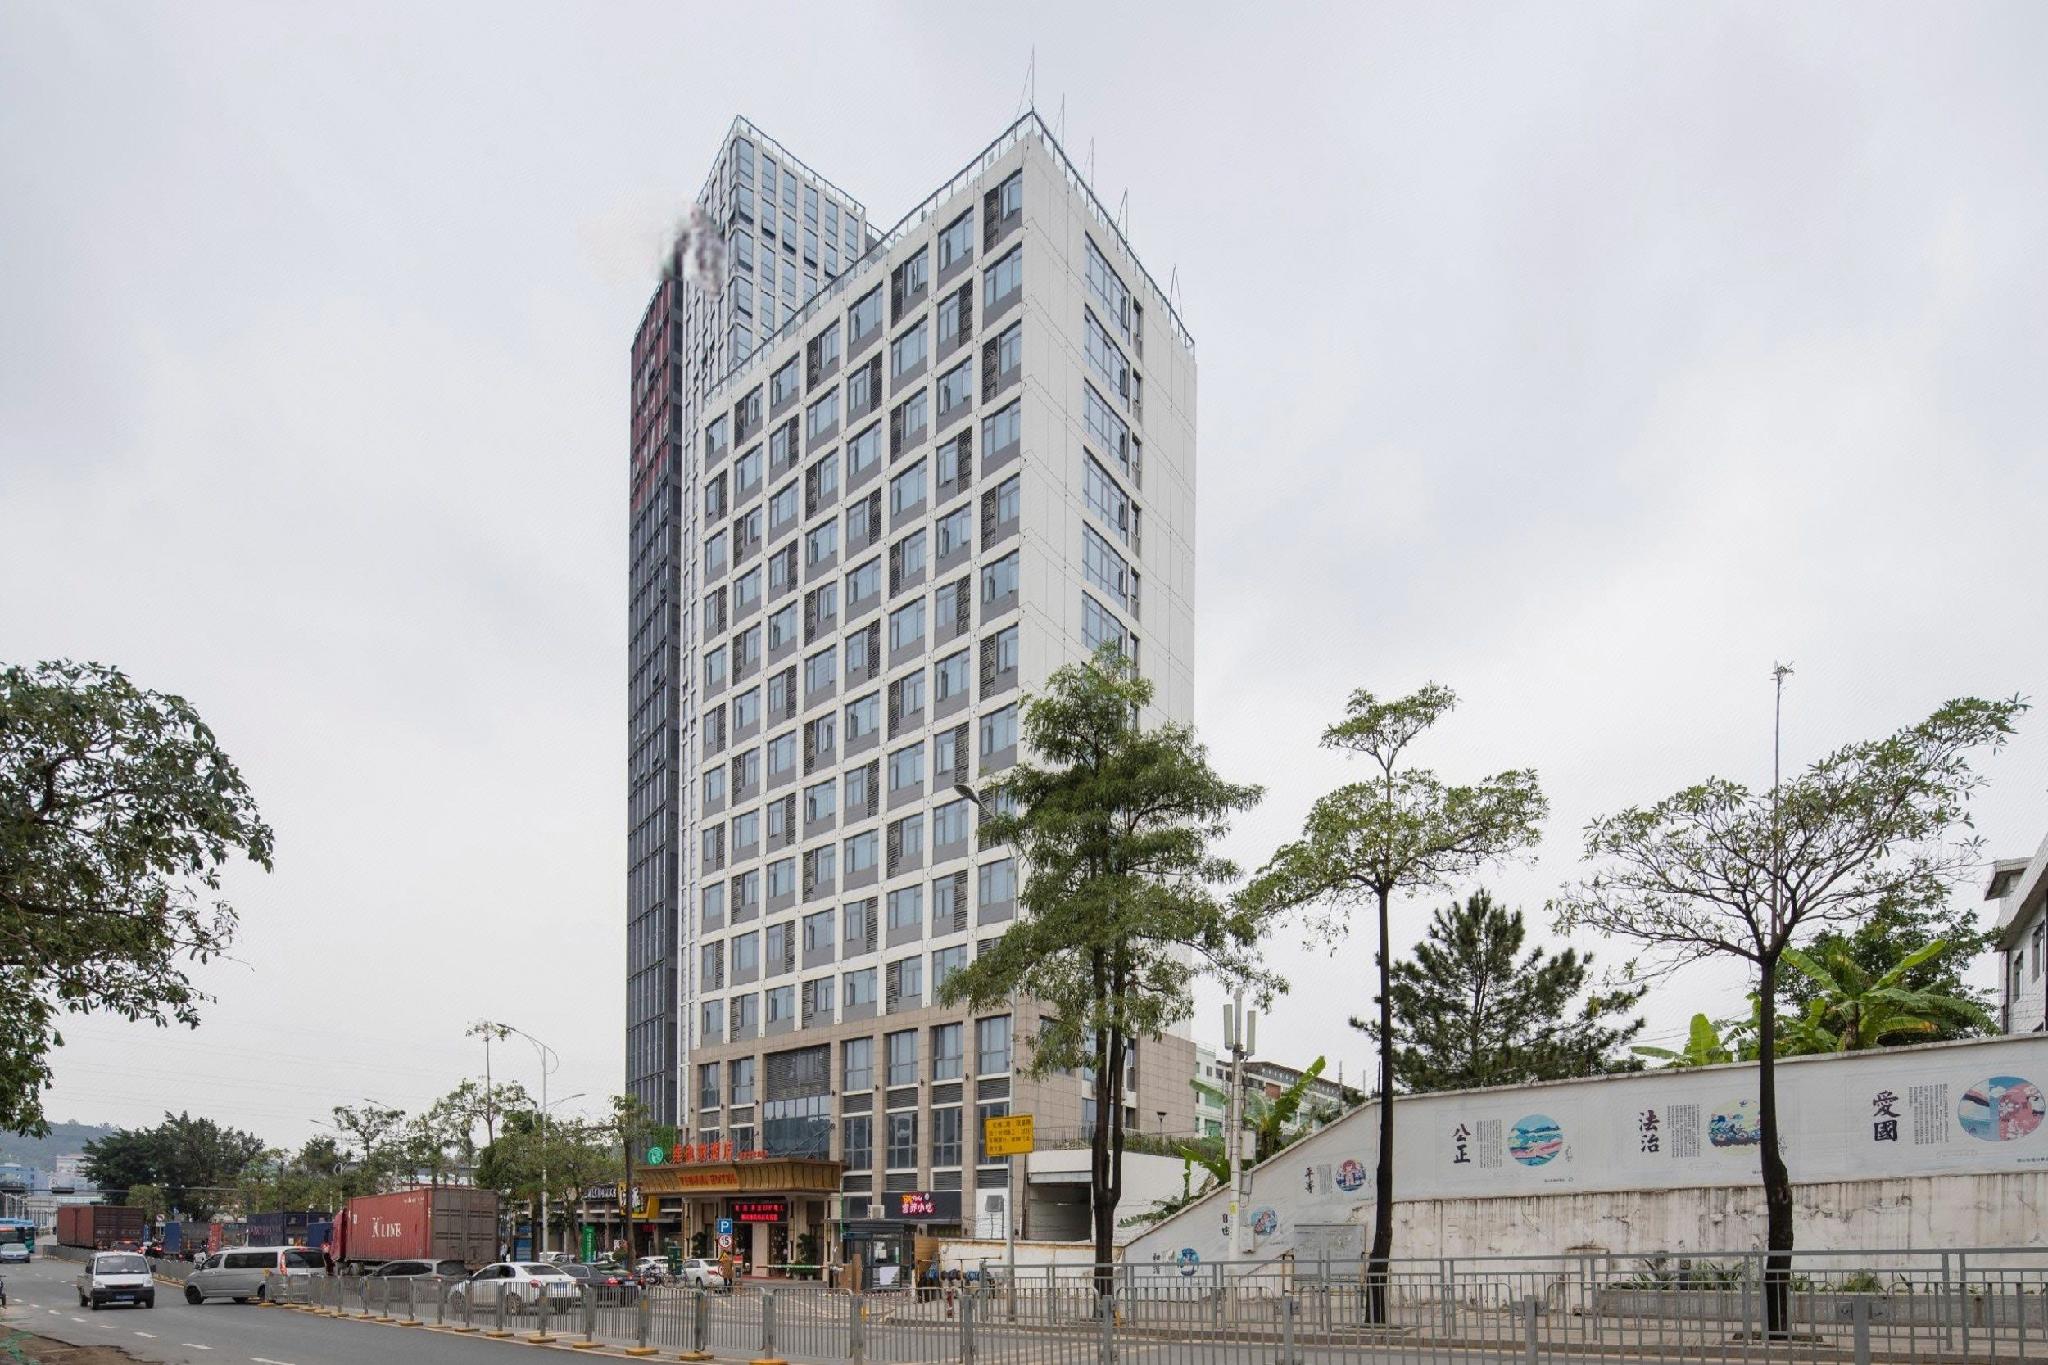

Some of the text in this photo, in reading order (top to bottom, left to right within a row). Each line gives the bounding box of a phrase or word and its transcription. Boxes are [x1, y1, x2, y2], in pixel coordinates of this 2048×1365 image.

[1453, 1123, 1471, 1163] 公正
[1639, 1110, 1660, 1152] 法治
[720, 1221, 729, 1233] P
